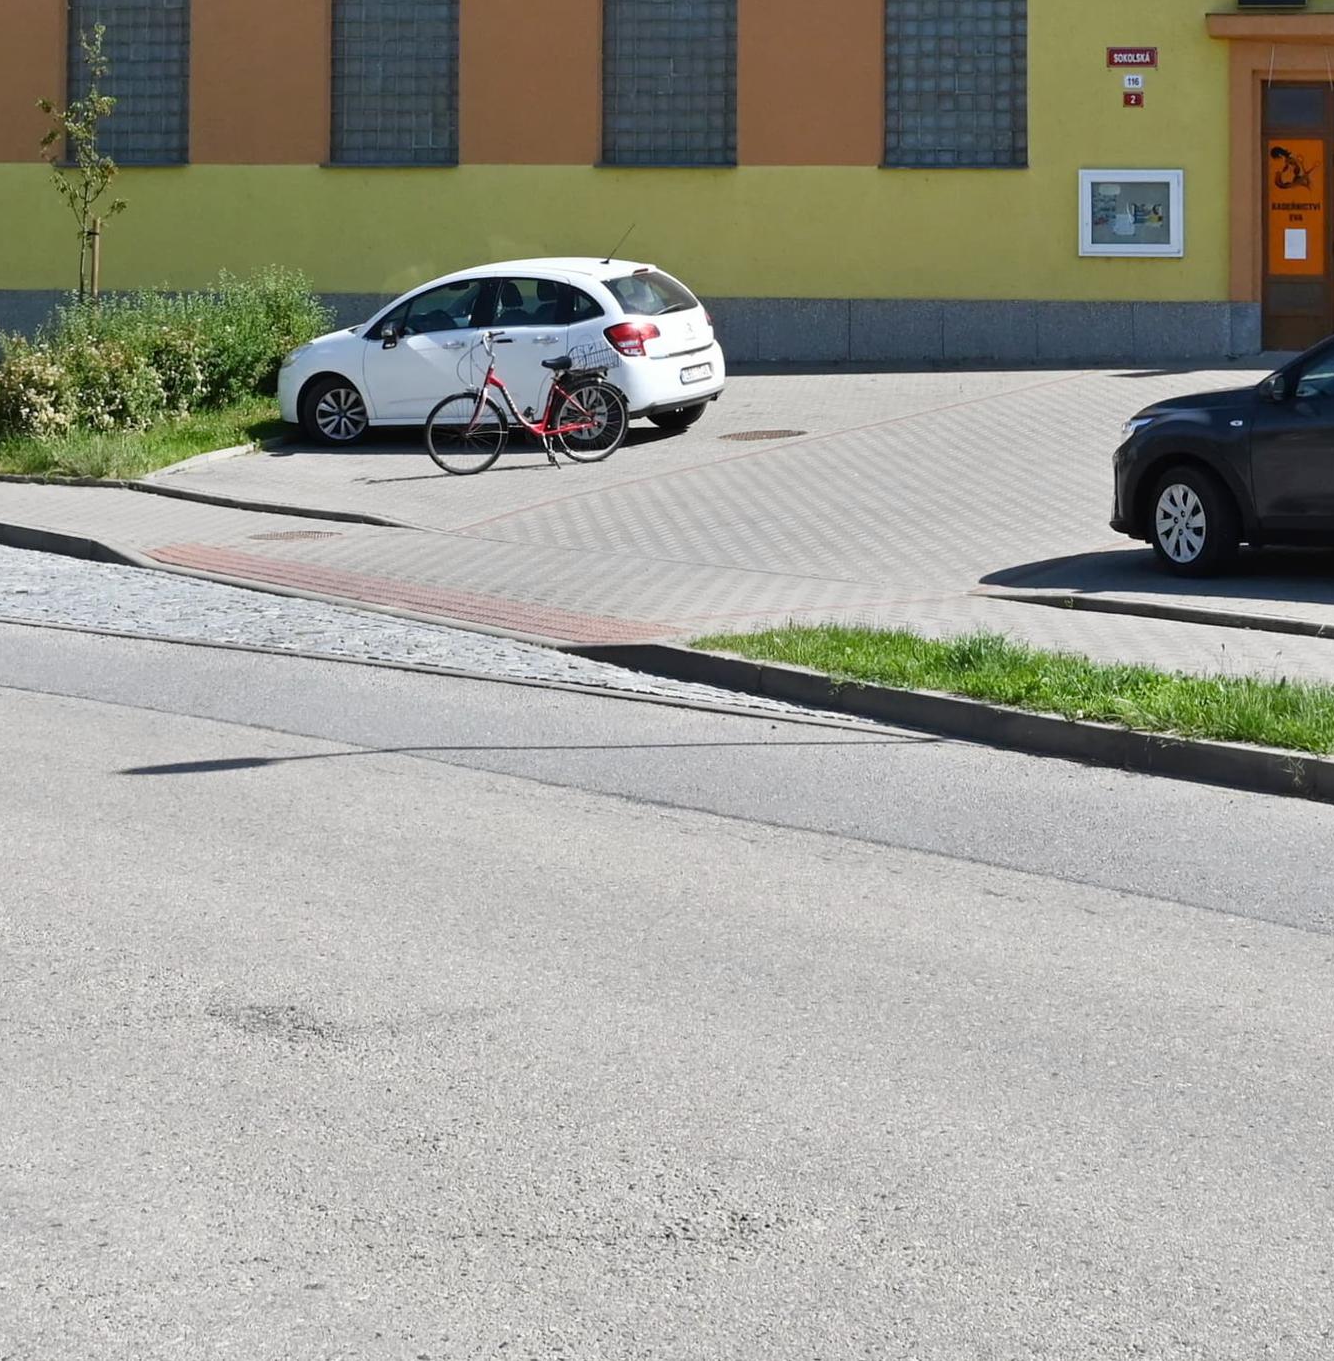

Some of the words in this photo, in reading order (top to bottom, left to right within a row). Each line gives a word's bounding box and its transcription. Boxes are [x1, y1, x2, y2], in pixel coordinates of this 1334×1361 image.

[1113, 51, 1151, 63] SOKOLSKÁ
[1127, 77, 1140, 86] 116
[1130, 95, 1136, 104] 2
